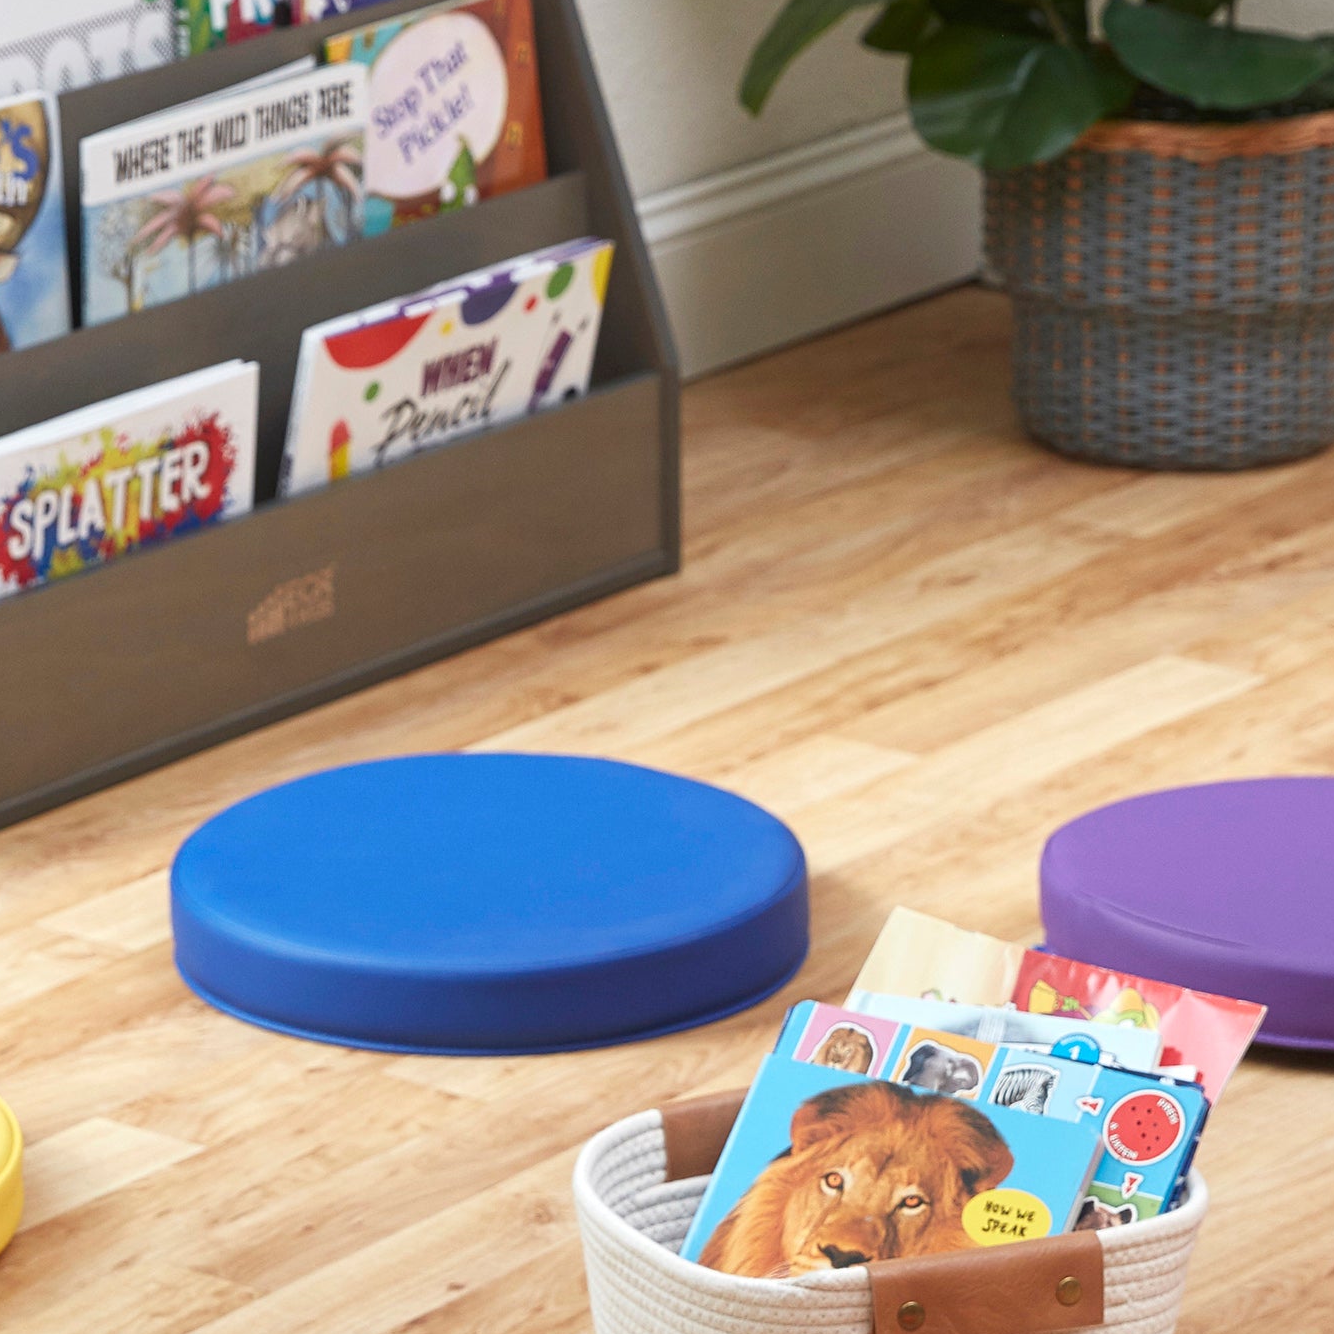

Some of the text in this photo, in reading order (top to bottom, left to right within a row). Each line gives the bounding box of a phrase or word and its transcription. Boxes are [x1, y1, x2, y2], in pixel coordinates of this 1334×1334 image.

[114, 80, 353, 184] WHERE THE WILD THINGS ARE
[421, 338, 499, 397] WHEN
[7, 440, 212, 562] SPLATTER
[982, 1218, 1027, 1237] SPEAK
[984, 1200, 1036, 1223] HOW WE
